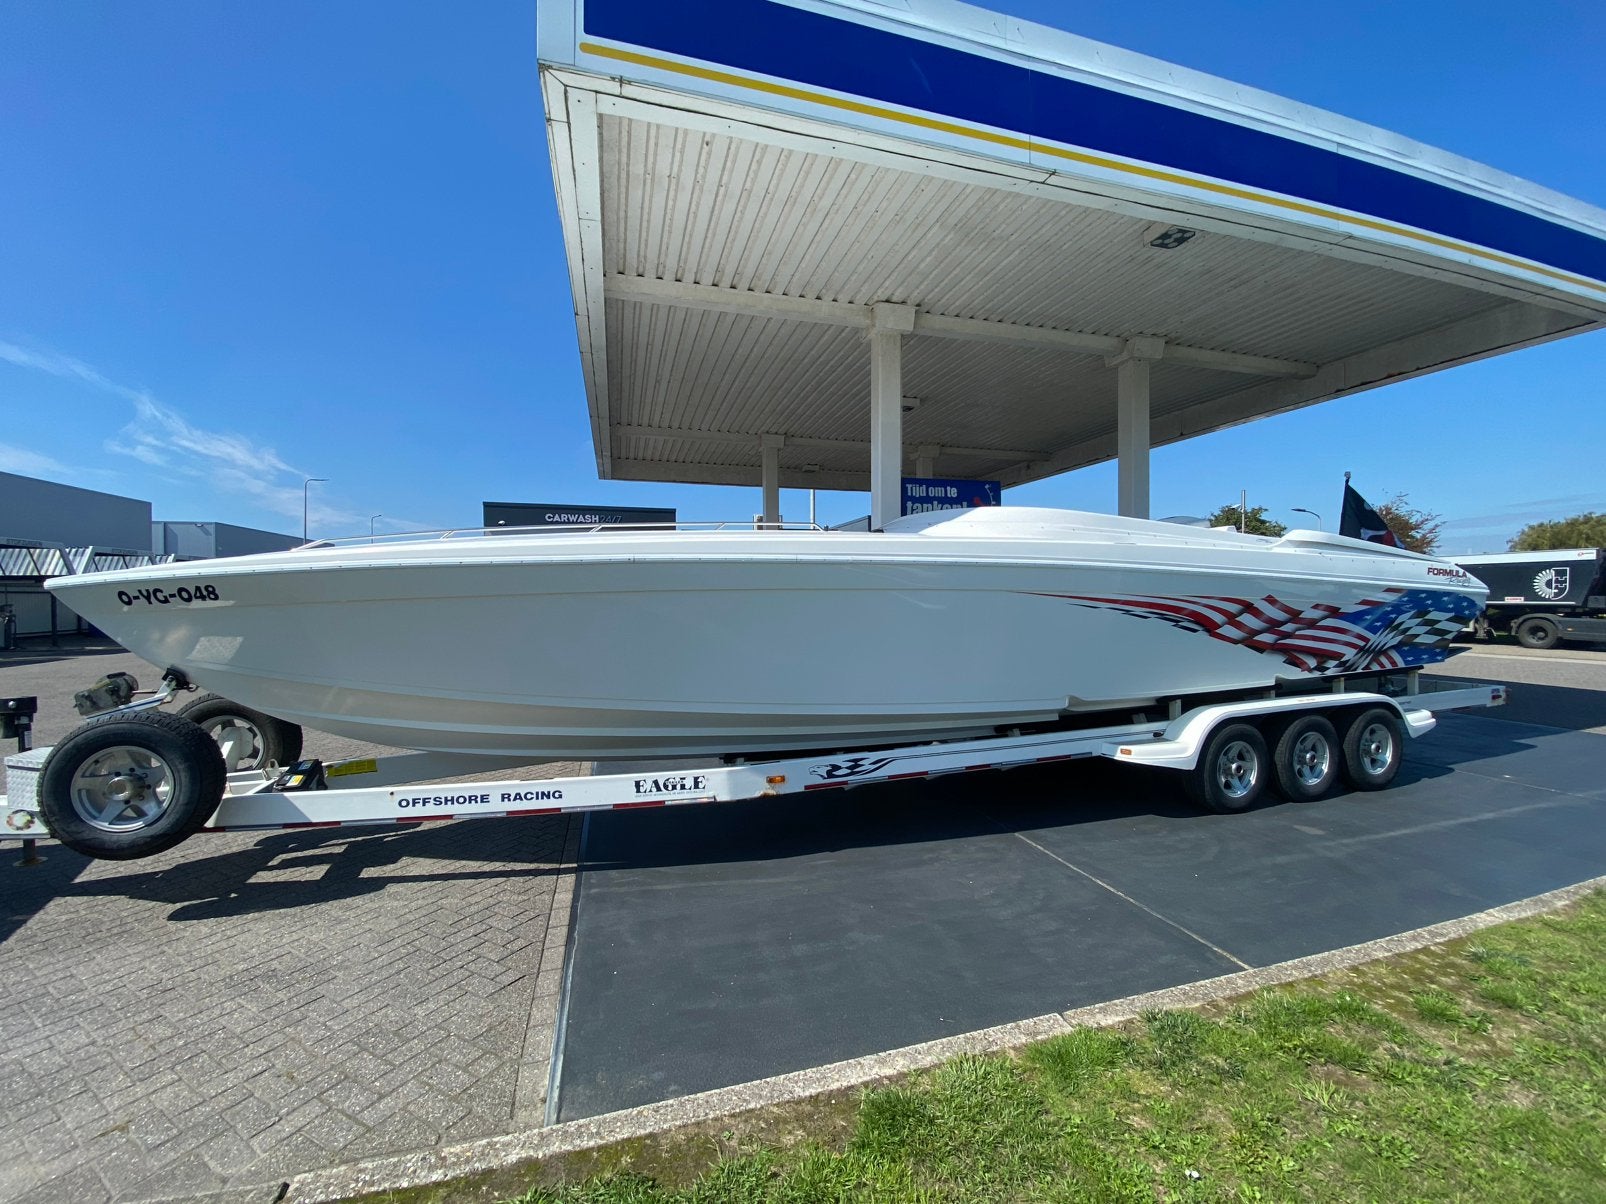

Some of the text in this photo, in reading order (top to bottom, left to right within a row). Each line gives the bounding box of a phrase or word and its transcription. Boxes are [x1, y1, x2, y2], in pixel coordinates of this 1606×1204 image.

[905, 483, 958, 498] Tijd om te
[545, 513, 599, 524] CARWASH
[1427, 567, 1468, 578] FORMULA
[633, 774, 707, 794] EAGLE
[397, 789, 564, 809] OFFSHORE RACING
